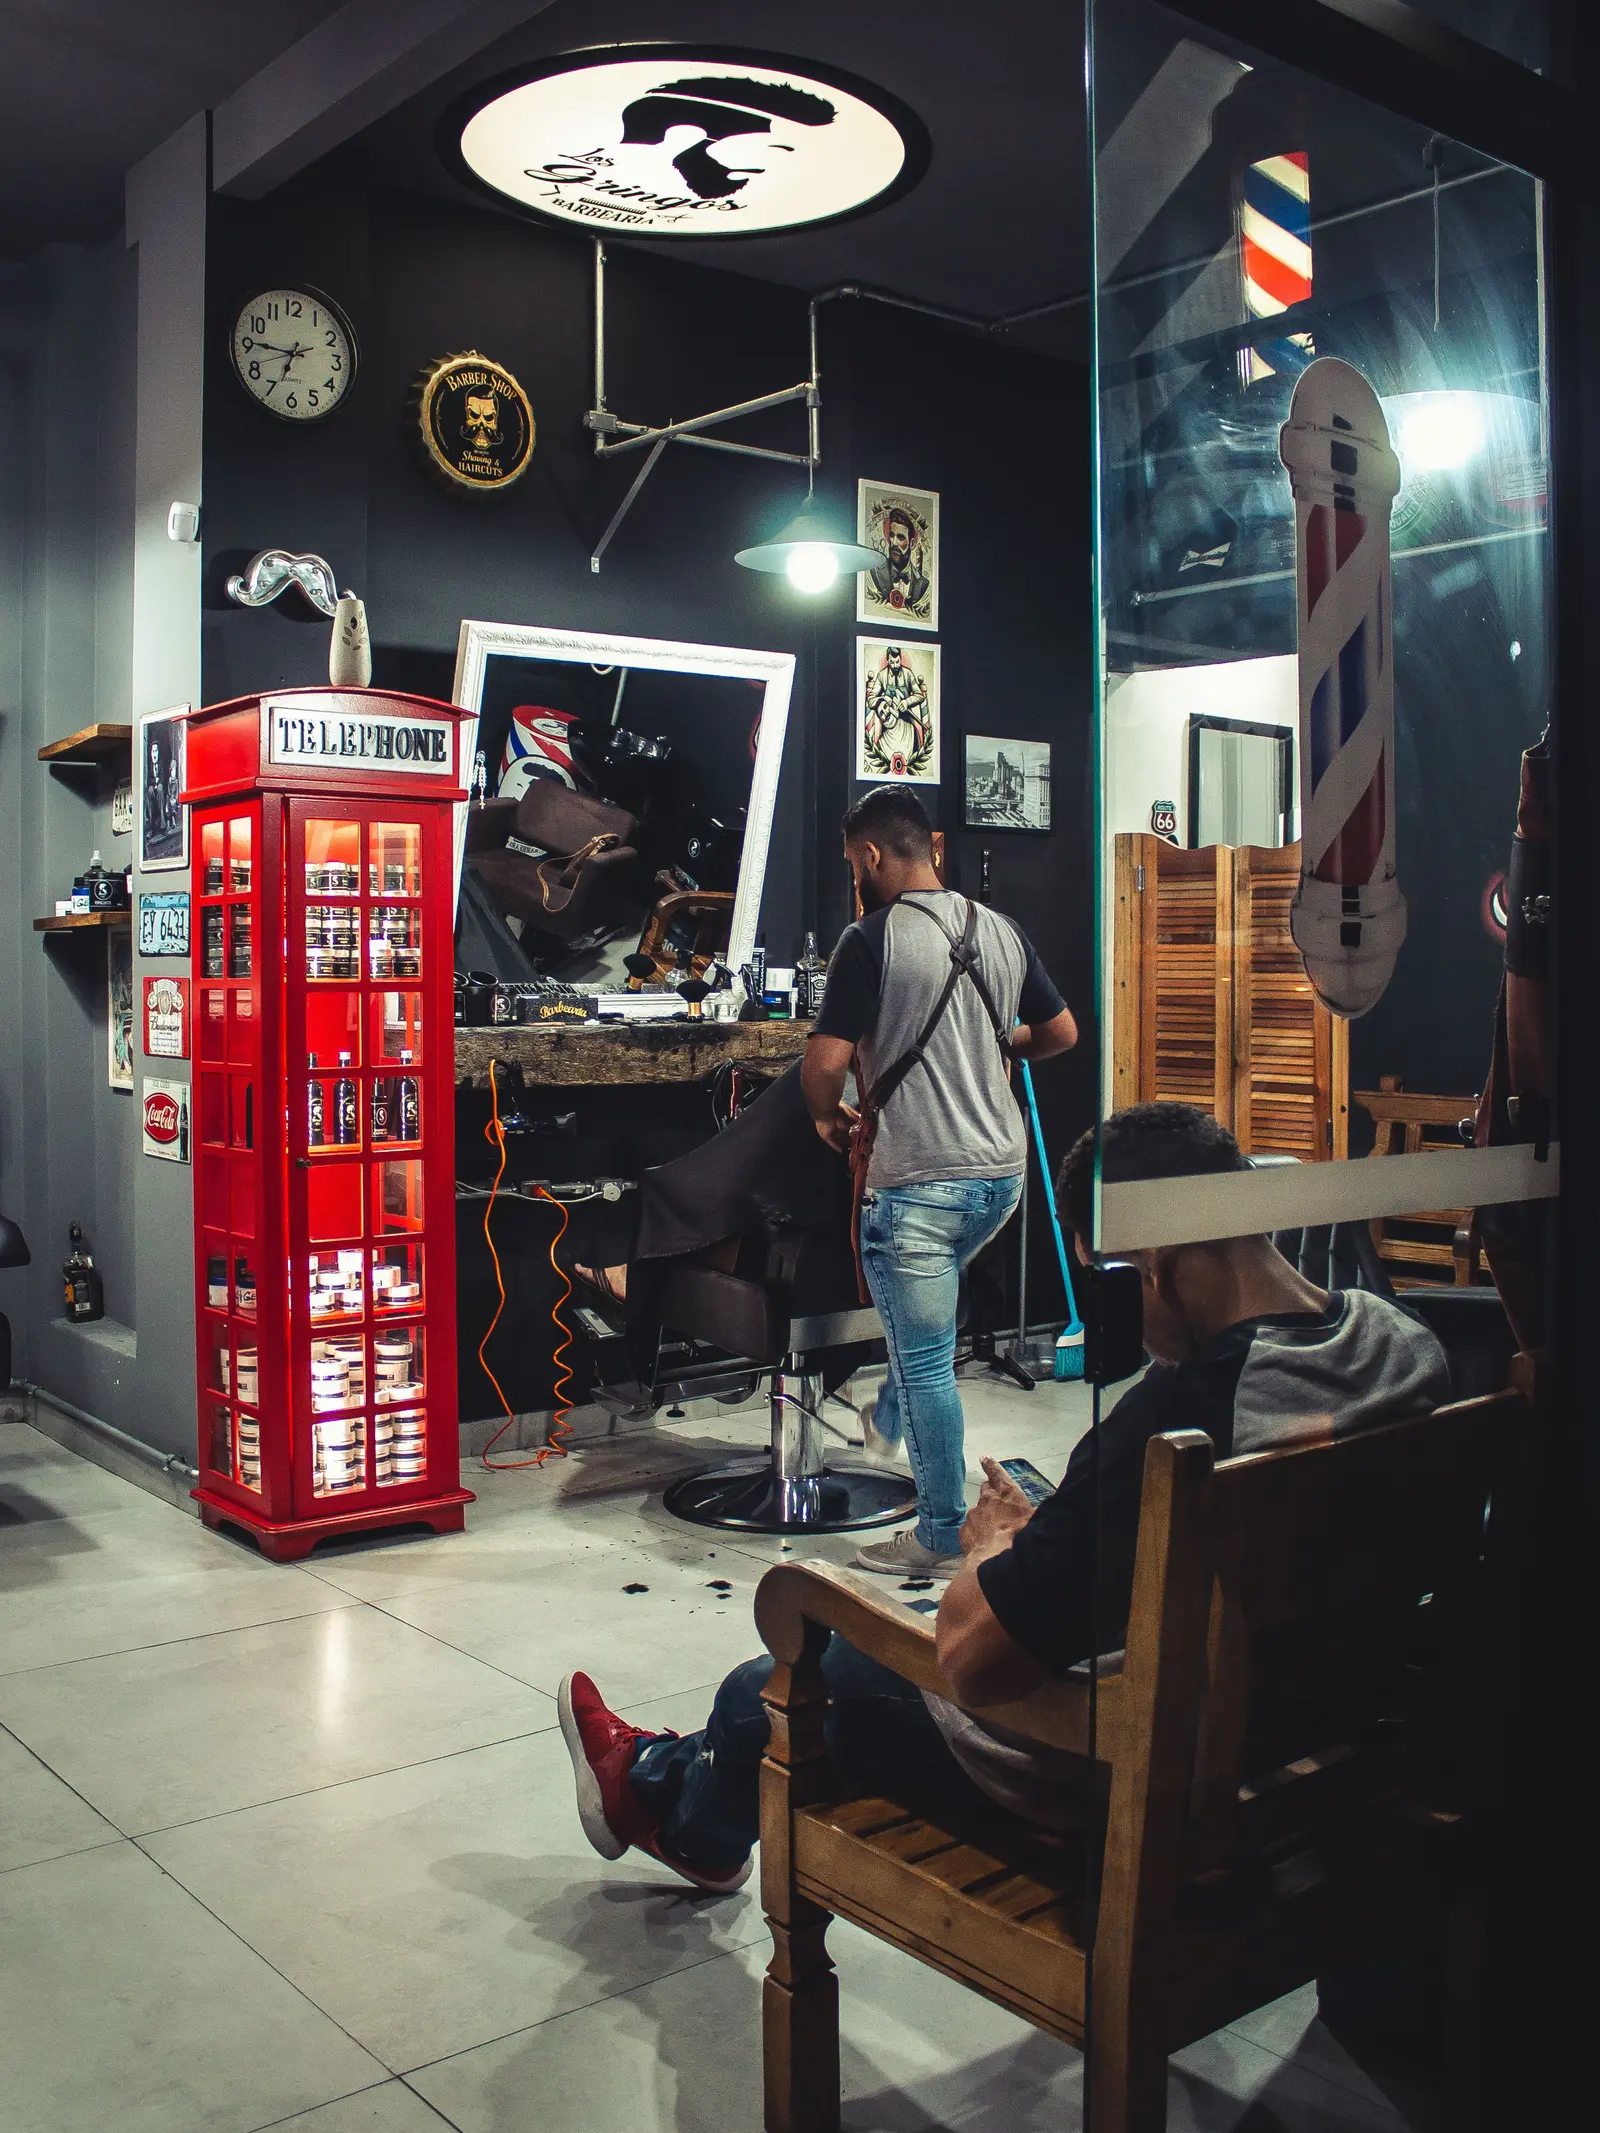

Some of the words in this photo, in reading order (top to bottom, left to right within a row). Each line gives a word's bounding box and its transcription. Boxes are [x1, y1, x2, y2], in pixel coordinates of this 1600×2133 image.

[557, 147, 616, 168] Los
[523, 164, 748, 211] Gringos
[552, 197, 654, 225] BARBEARIA
[268, 302, 279, 321] 11
[286, 299, 302, 318] 12
[250, 315, 266, 335] 10
[313, 310, 318, 328] 1
[241, 336, 254, 354] 9
[325, 330, 337, 348] 2
[248, 360, 261, 380] 8
[330, 354, 342, 372] 3
[265, 379, 278, 396] 7
[323, 377, 336, 393] 4
[445, 371, 488, 393] BARBER
[489, 373, 518, 401] SHOP
[285, 391, 298, 409] 6
[307, 389, 319, 407] 5
[461, 450, 492, 467] Shaving
[494, 458, 501, 467] &
[458, 461, 504, 477] HAIRCUTS
[278, 717, 448, 763] TELEPHONE
[1157, 813, 1174, 829] 66
